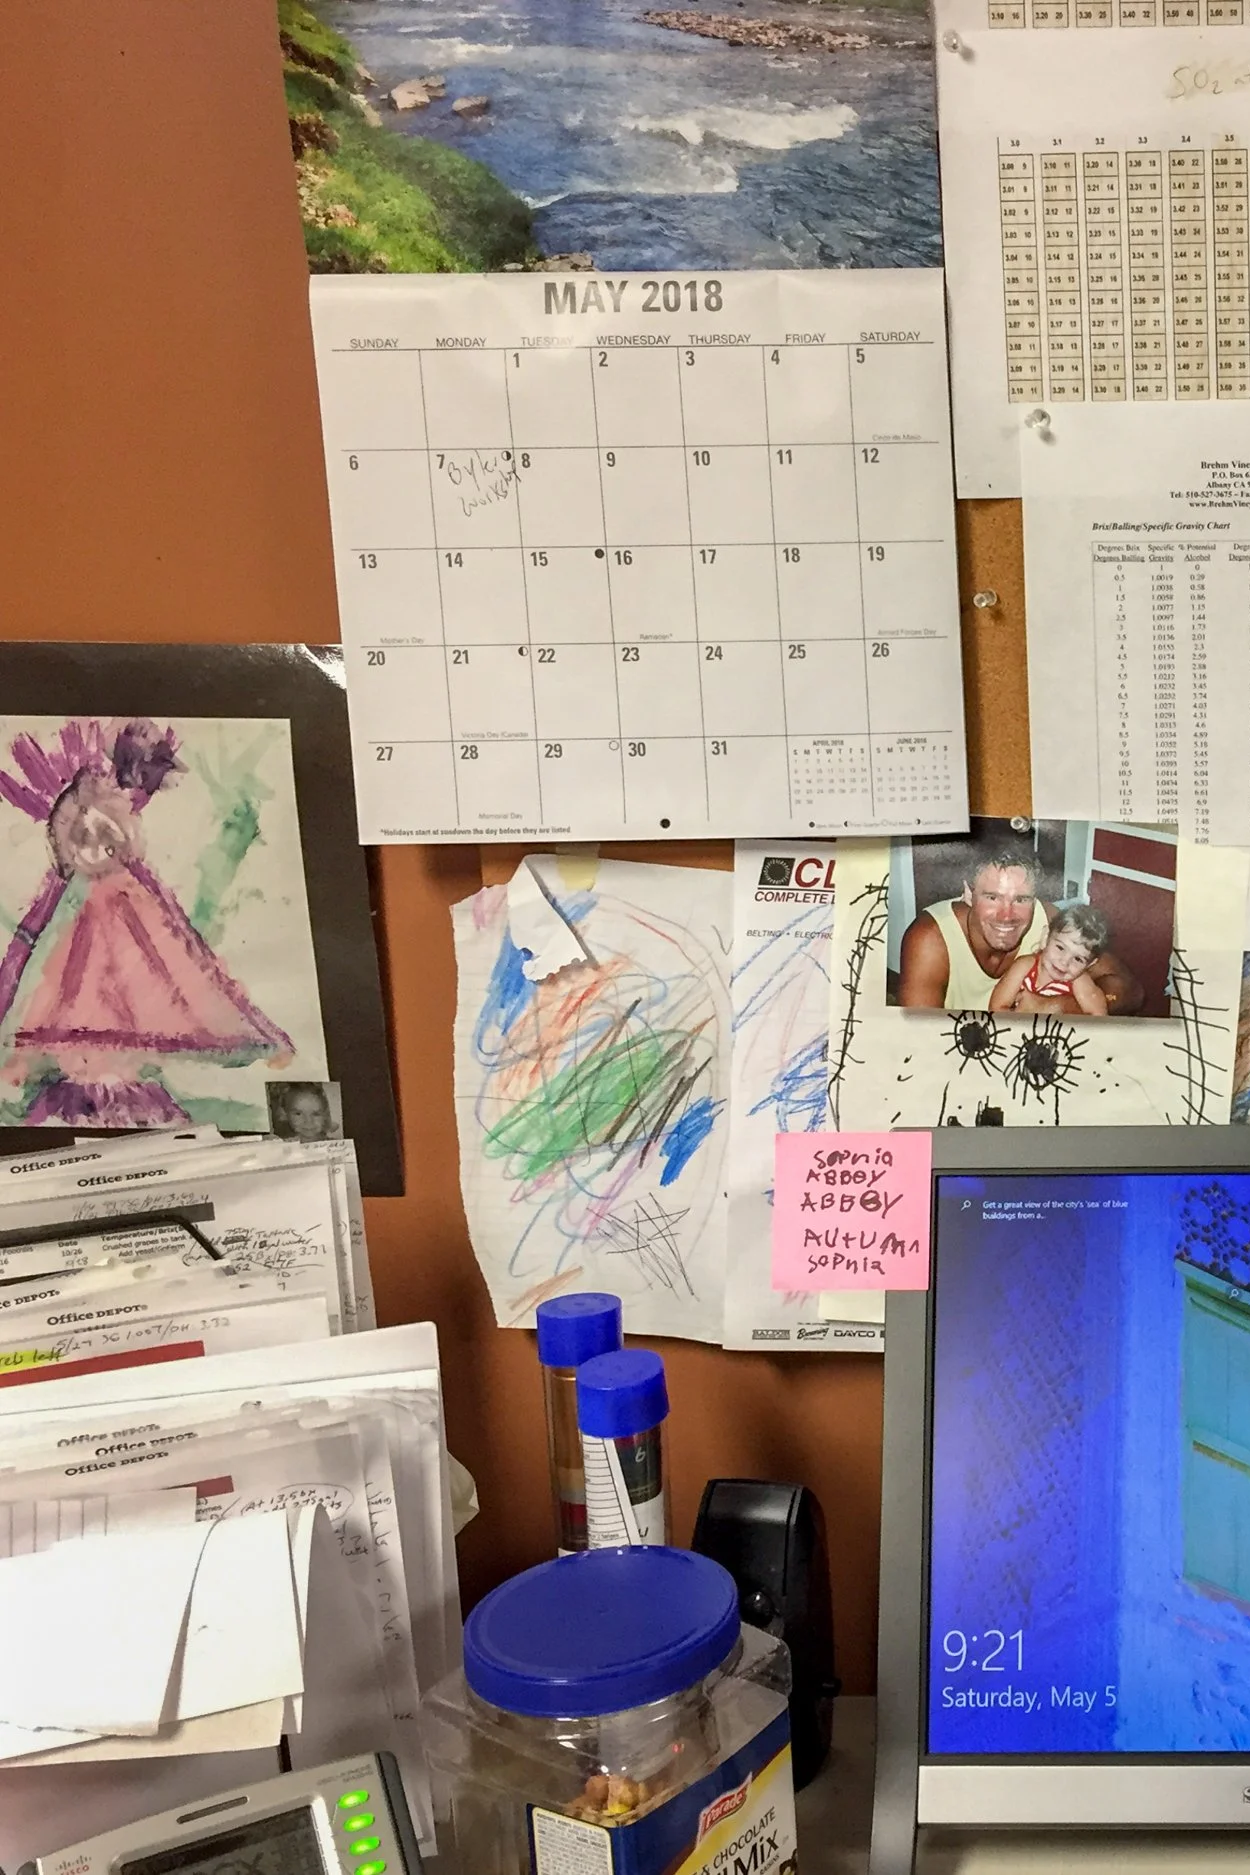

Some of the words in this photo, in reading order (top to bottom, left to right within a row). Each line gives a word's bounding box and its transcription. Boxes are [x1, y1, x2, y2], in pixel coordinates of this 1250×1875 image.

[544, 280, 628, 314] MAY
[641, 280, 723, 312] 2018
[350, 338, 398, 349] SUNDAY
[436, 337, 487, 348] MONDAY
[521, 336, 574, 347] TUESDAY
[596, 334, 670, 346] WEDNESDAY
[688, 334, 751, 344] THURSDAY
[786, 332, 826, 344] FRIDAY
[860, 331, 921, 342] SATURDAY
[512, 352, 520, 368] 1
[598, 350, 608, 368] 2
[686, 350, 696, 366] 3
[770, 350, 780, 366] 4
[856, 348, 866, 364] 5
[348, 454, 358, 470] 6
[436, 454, 446, 470] 7
[520, 452, 532, 468] 8
[606, 452, 616, 468] 9
[692, 450, 710, 466] 10
[776, 448, 792, 464] 11
[862, 448, 880, 464] 12
[1201, 461, 1228, 469] Brehm
[1206, 481, 1228, 490] Albany
[1176, 522, 1205, 532] Gravity
[1207, 522, 1230, 530] Chart
[358, 554, 378, 570] 13
[444, 552, 464, 568] 14
[530, 552, 548, 566] 15
[614, 550, 632, 566] 16
[700, 548, 716, 564] 17
[782, 548, 800, 564] 18
[866, 546, 884, 562] 19
[366, 650, 386, 666] 20
[452, 648, 470, 664] 21
[538, 648, 556, 664] 22
[622, 646, 640, 662] 23
[704, 646, 724, 660] 24
[788, 644, 806, 660] 25
[872, 642, 890, 658] 26
[376, 746, 394, 762] 27
[460, 744, 478, 760] 28
[544, 744, 562, 758] 29
[628, 742, 646, 758] 30
[710, 740, 728, 756] 31
[754, 891, 828, 904] COMPLETE
[746, 930, 782, 938] BELTING
[10, 1160, 55, 1174] Office
[59, 1154, 96, 1166] DEPOT
[78, 1175, 122, 1187] Office
[126, 1169, 163, 1181] DEPOT
[1004, 1201, 1023, 1211] great
[1065, 1201, 1084, 1210] city's
[1103, 1200, 1111, 1208] of
[1112, 1200, 1128, 1208] blue
[983, 1212, 1016, 1221] buildings
[47, 1310, 94, 1326] Office
[96, 1305, 141, 1318] DEPOT
[834, 1330, 875, 1338] DAYCO
[65, 1462, 116, 1476] Office
[120, 1452, 164, 1466] DEPOT
[942, 1629, 1025, 1673] 9:21
[942, 1685, 1042, 1714] Saturday,
[1050, 1686, 1099, 1713] May
[1105, 1686, 1117, 1706] 5
[705, 1791, 746, 1826] Parade
[713, 1806, 776, 1867] CHOCOLATE
[733, 1829, 780, 1875] Mix
